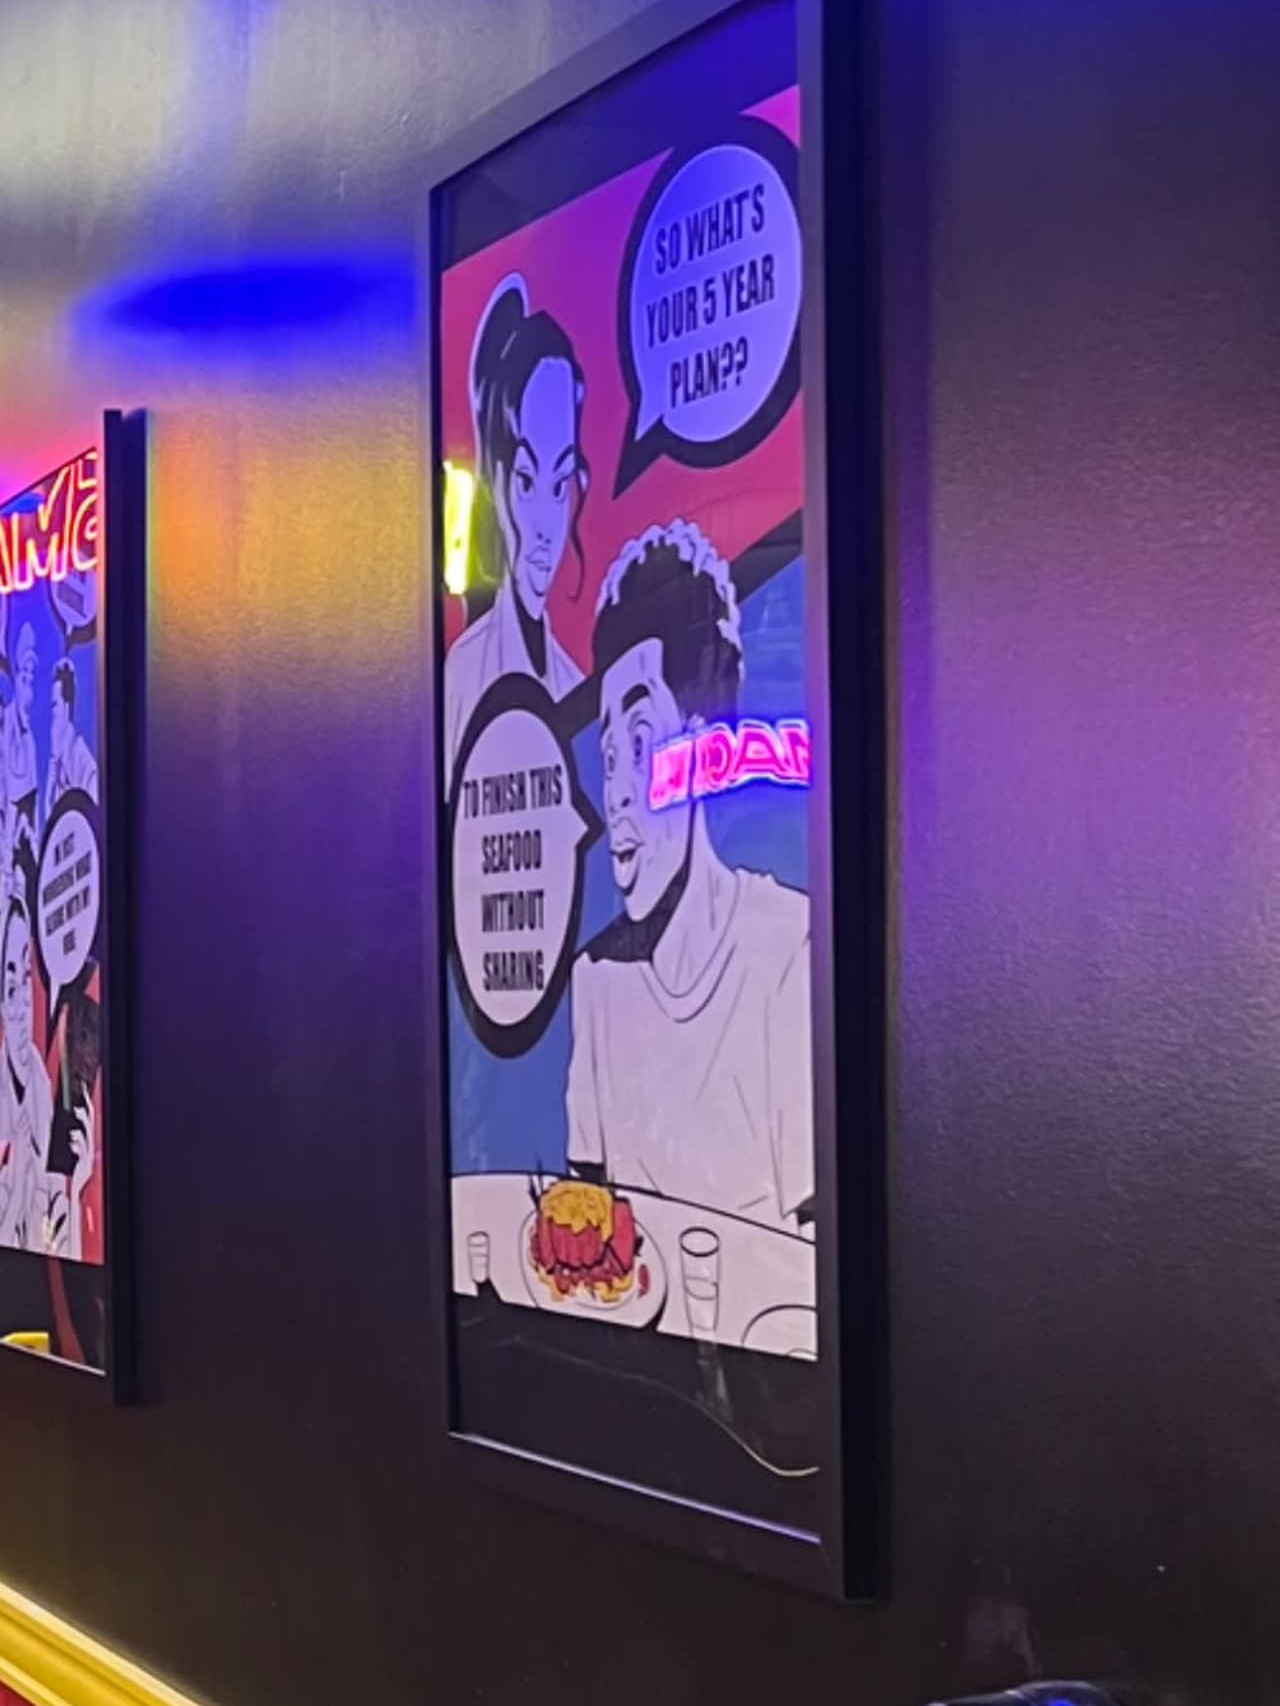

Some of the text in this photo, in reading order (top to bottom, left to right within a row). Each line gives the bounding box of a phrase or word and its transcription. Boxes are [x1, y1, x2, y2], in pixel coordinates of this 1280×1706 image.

[655, 221, 682, 275] SO
[646, 253, 775, 349] YOUR 5 YEAR
[670, 336, 749, 409] PLAN??
[463, 765, 563, 820] TO FINISH THIS
[482, 829, 542, 875] SEAFOOD
[481, 889, 545, 933] WITHOUT
[483, 949, 545, 991] SHARING
